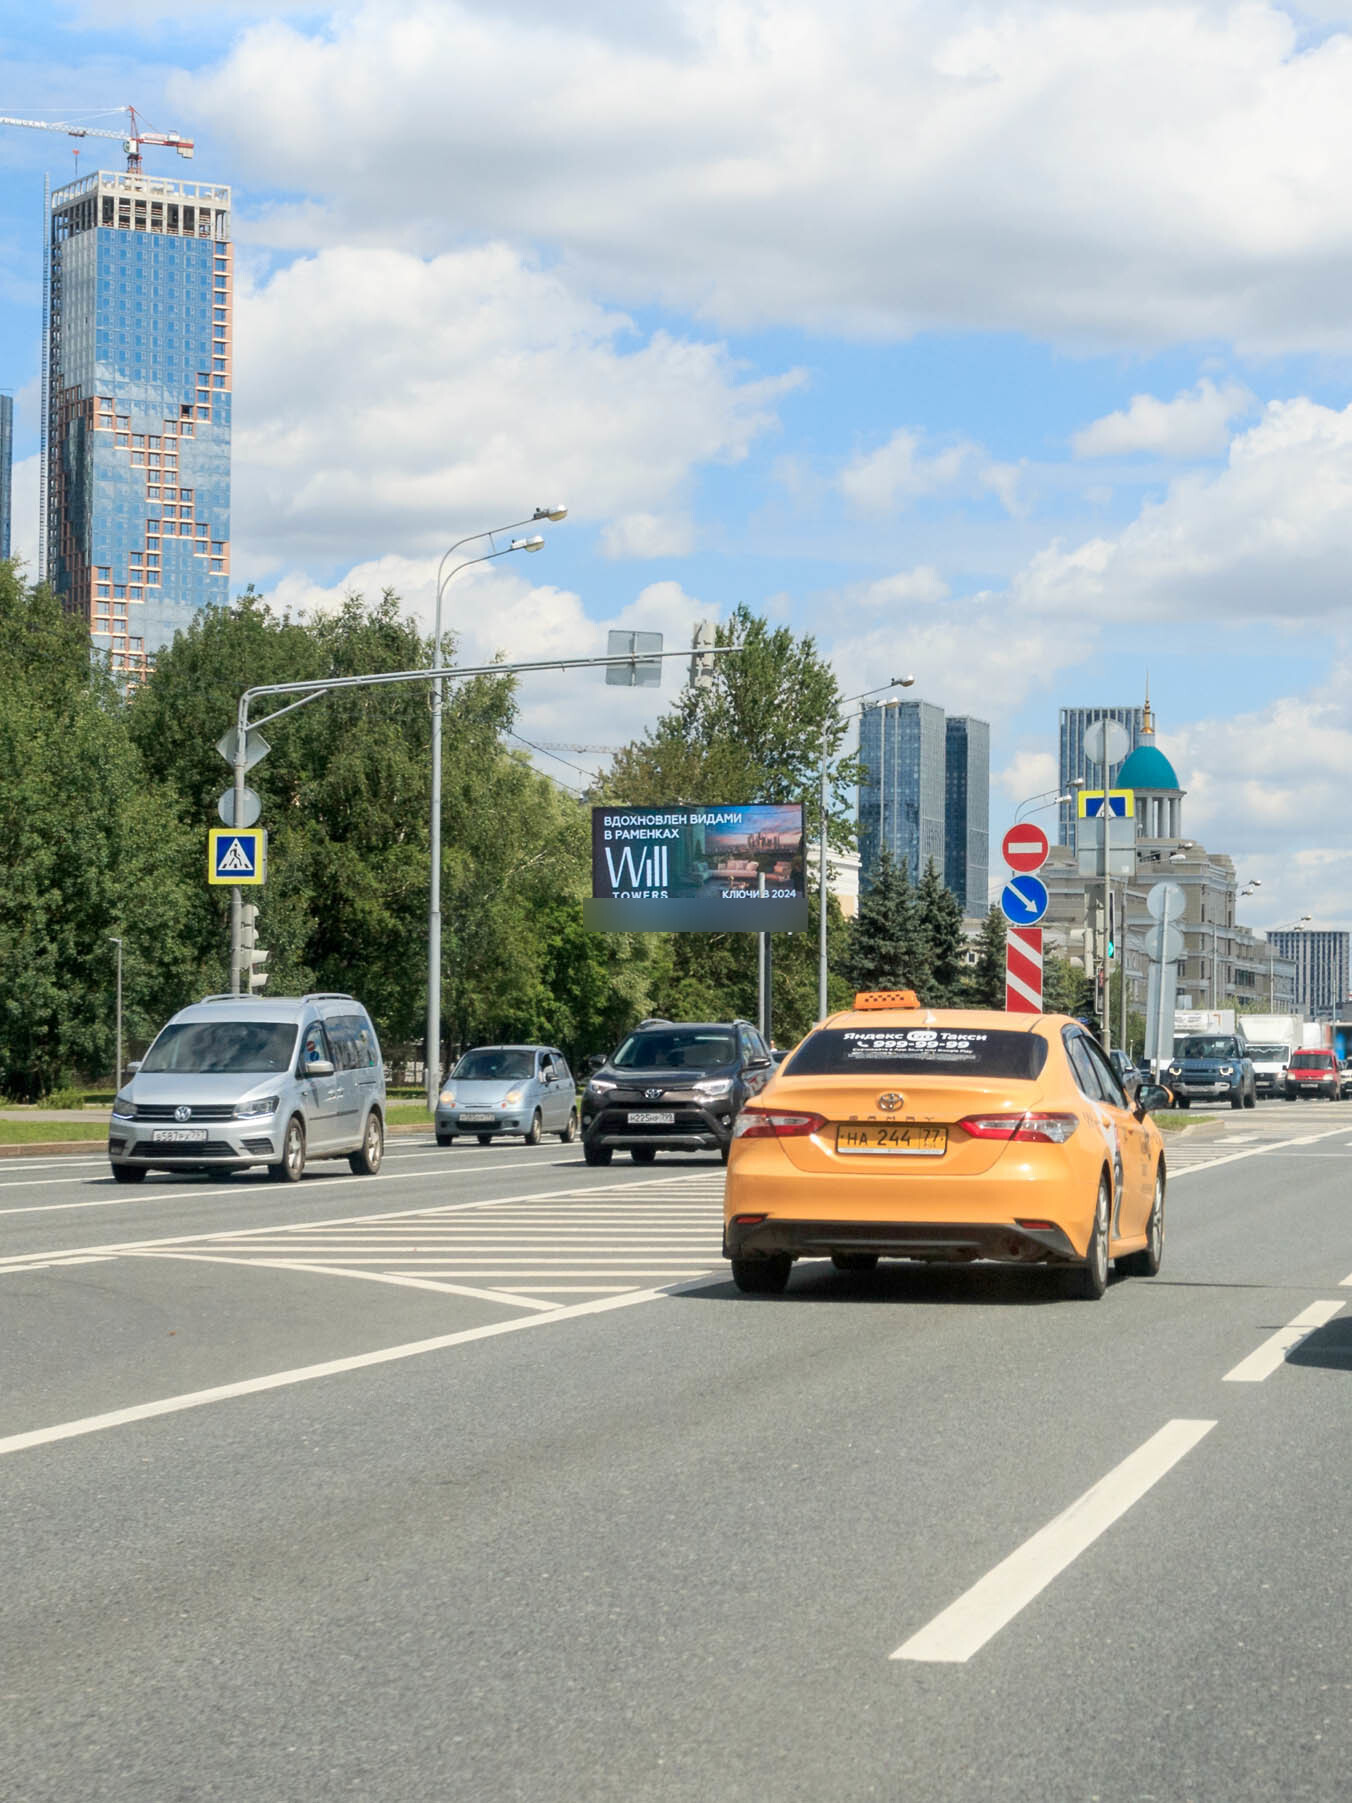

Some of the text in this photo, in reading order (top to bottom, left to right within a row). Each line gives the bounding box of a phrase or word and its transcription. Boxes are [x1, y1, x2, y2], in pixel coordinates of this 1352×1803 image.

[604, 813, 742, 827] ВДОХНОВЛЕН ВИДАМИ
[604, 829, 680, 840] В РАМЕНКАХ
[722, 889, 760, 899] КЛЮЧИ
[771, 889, 797, 898] 2024
[843, 1032, 905, 1041] Яндекс
[940, 1032, 988, 1042] Такси
[873, 1040, 970, 1049] 999-99-99
[877, 1128, 911, 1146] 244
[923, 1128, 940, 1143] 77
